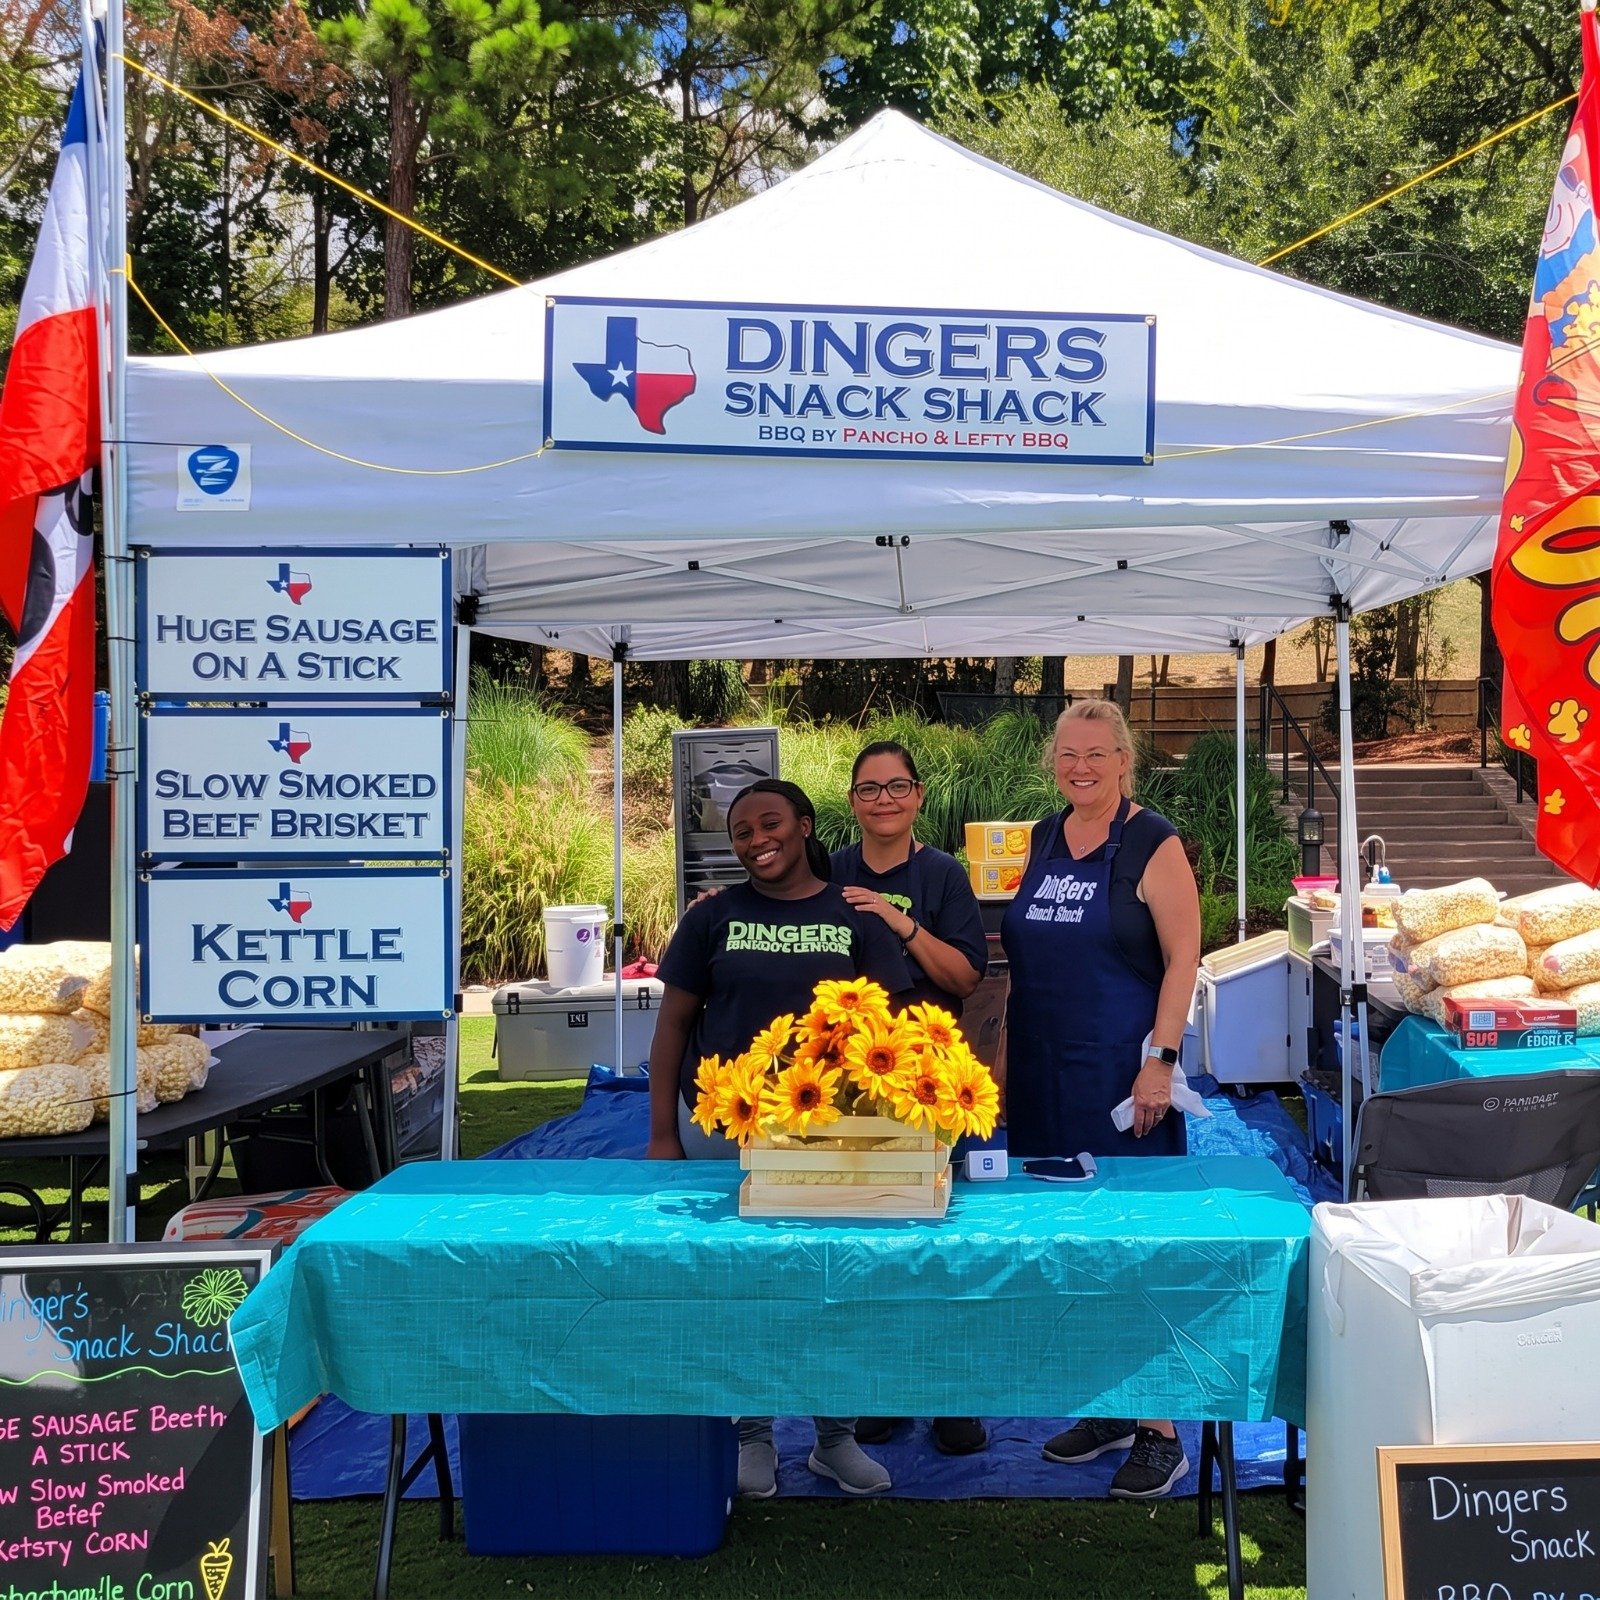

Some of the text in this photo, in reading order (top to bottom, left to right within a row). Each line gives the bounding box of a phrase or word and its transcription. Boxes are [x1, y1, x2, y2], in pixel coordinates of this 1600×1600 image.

[725, 317, 1107, 384] DINGERS
[724, 381, 1107, 426] SNACK SHACK
[758, 425, 1069, 449] BBQ BY PANCHO & LEFTY BBQ
[156, 614, 438, 643] HUGE SAUSAGE
[257, 651, 287, 681] A
[297, 651, 402, 681] STICK
[155, 769, 438, 800] SLOW SMOKED
[162, 808, 430, 840] BEEF BRISKET
[191, 923, 404, 963] KETTLE
[727, 921, 852, 945] DINGERS
[218, 969, 379, 1009] CORN
[53, 1325, 141, 1361] Snack
[32, 1409, 139, 1437] SAUSAGE
[31, 1441, 131, 1466] A STICK
[30, 1478, 86, 1502] Slow
[97, 1467, 185, 1497] Smoked
[37, 1501, 105, 1529] Befef
[1428, 1476, 1568, 1534] Dingers
[1511, 1529, 1596, 1563] Snack
[136, 1573, 195, 1600] Corn
